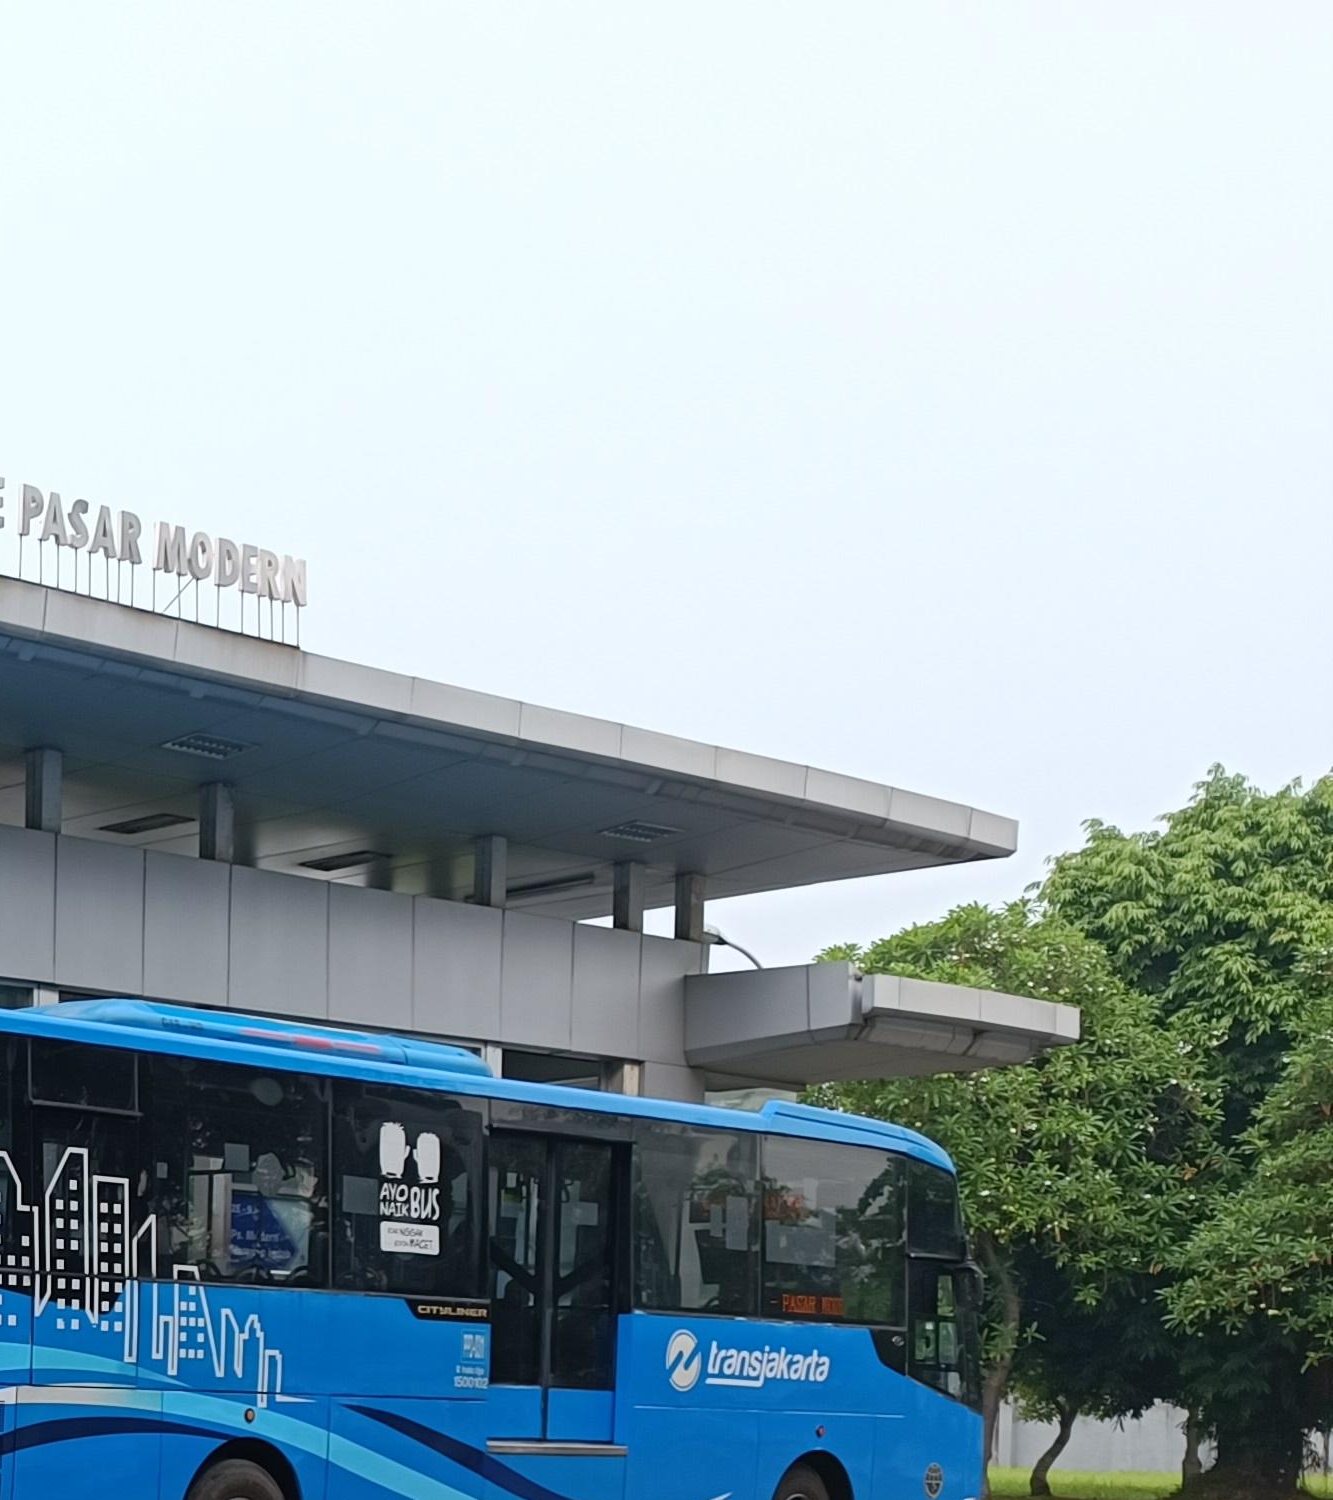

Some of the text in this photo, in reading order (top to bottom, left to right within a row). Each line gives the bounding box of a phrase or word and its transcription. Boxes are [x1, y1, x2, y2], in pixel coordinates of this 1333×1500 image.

[17, 483, 142, 564] PASAR
[153, 521, 307, 606] MODERN
[379, 1182, 409, 1202] AYO
[410, 1186, 440, 1220] BUS
[379, 1201, 409, 1217] NAIK
[418, 1305, 487, 1318] CITYLINER
[705, 1340, 831, 1388] transjakarta
